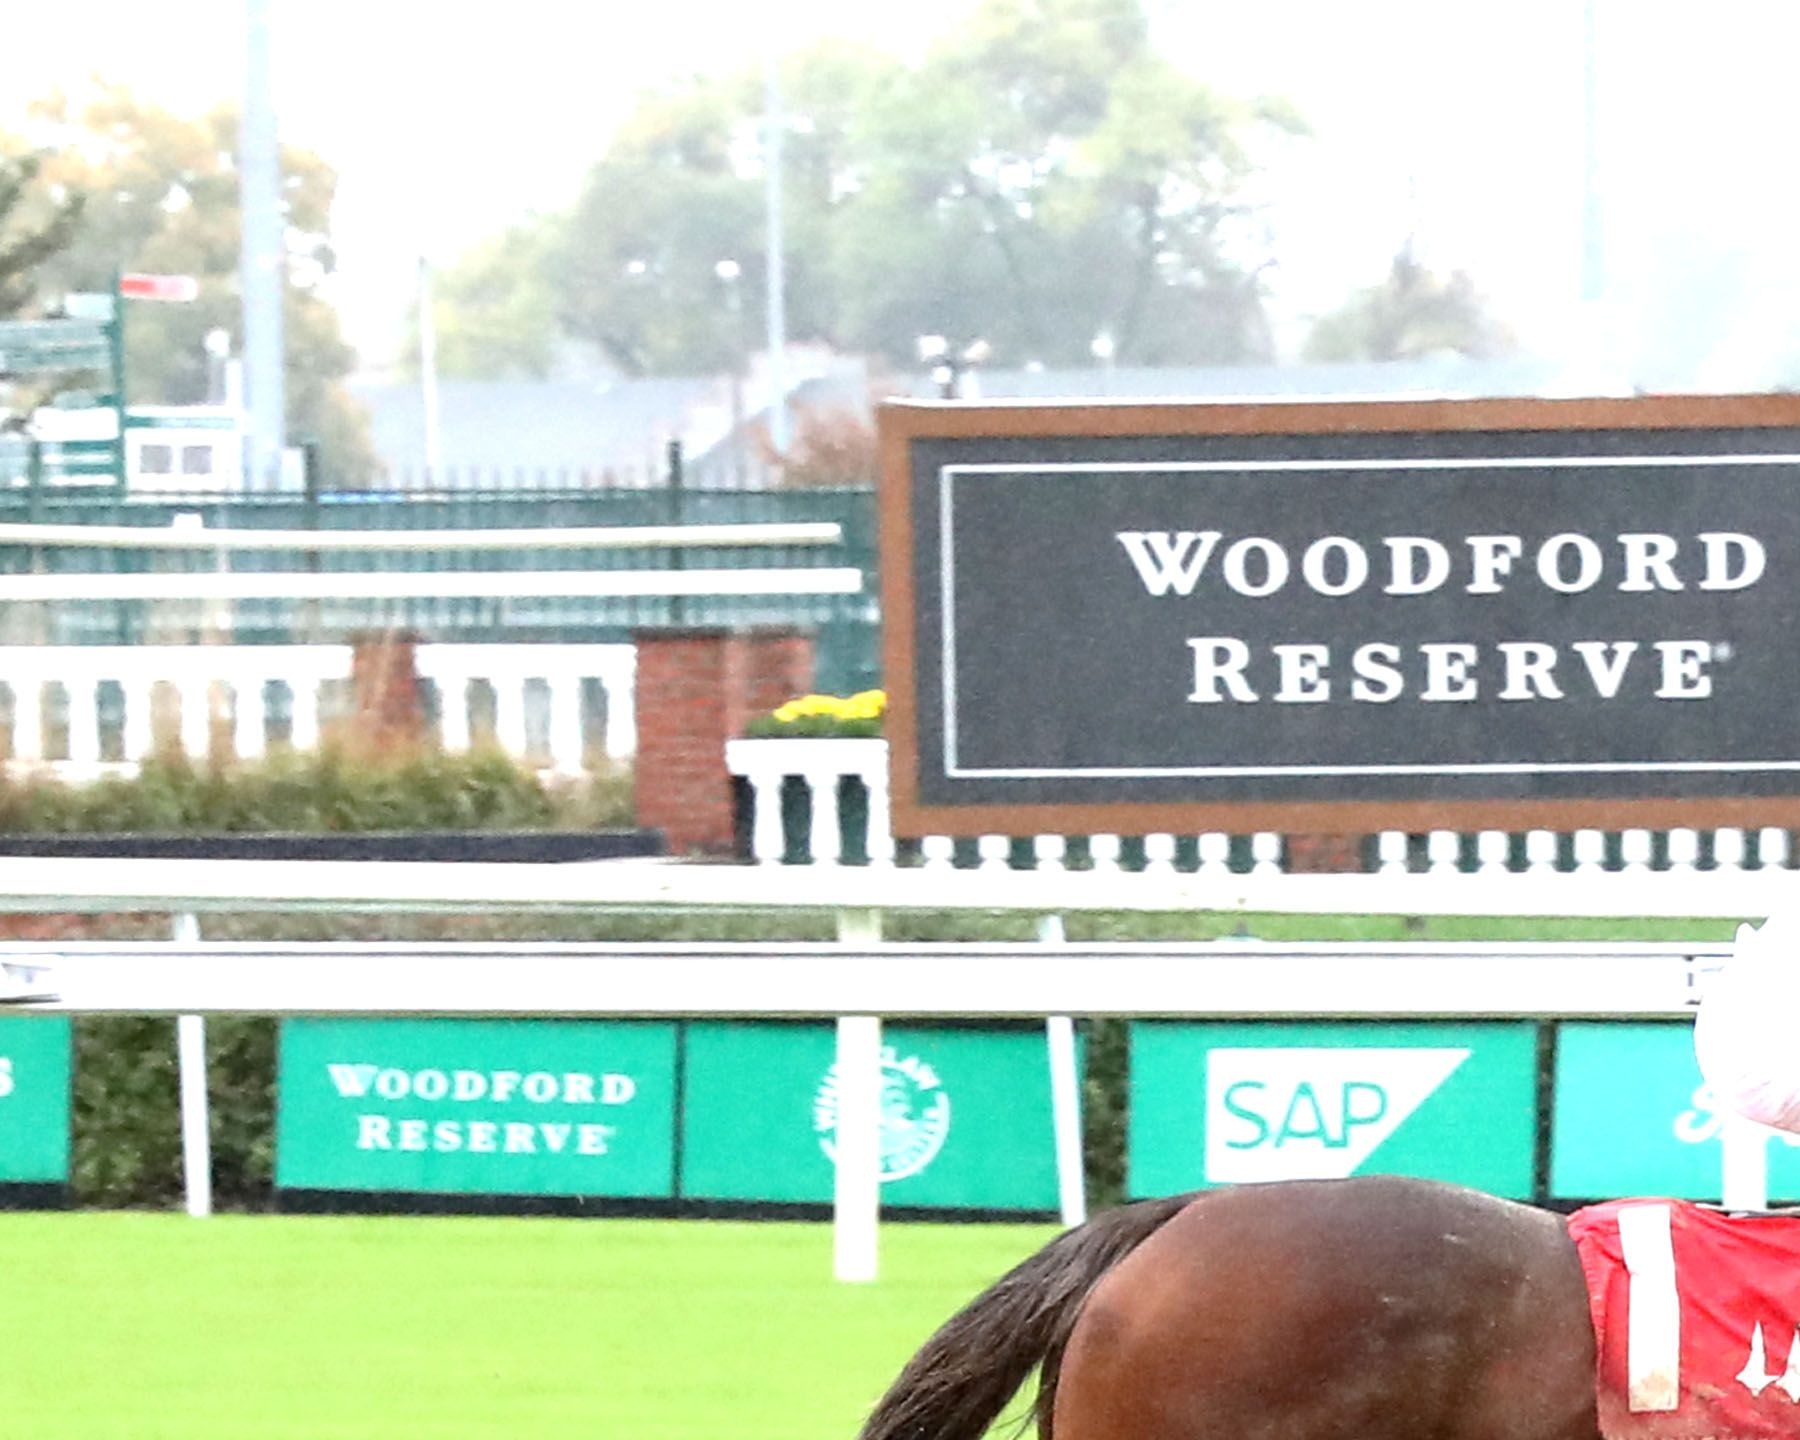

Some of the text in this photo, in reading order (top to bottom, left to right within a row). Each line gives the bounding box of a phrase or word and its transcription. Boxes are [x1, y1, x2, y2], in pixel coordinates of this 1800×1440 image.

[1116, 531, 1767, 597] WOODFORD
[1186, 637, 1713, 703] RESERVE
[328, 1064, 637, 1105] WOODFORD
[1223, 1081, 1389, 1149] SAP
[357, 1115, 612, 1155] RESERVE
[1617, 1204, 1680, 1412] 1
